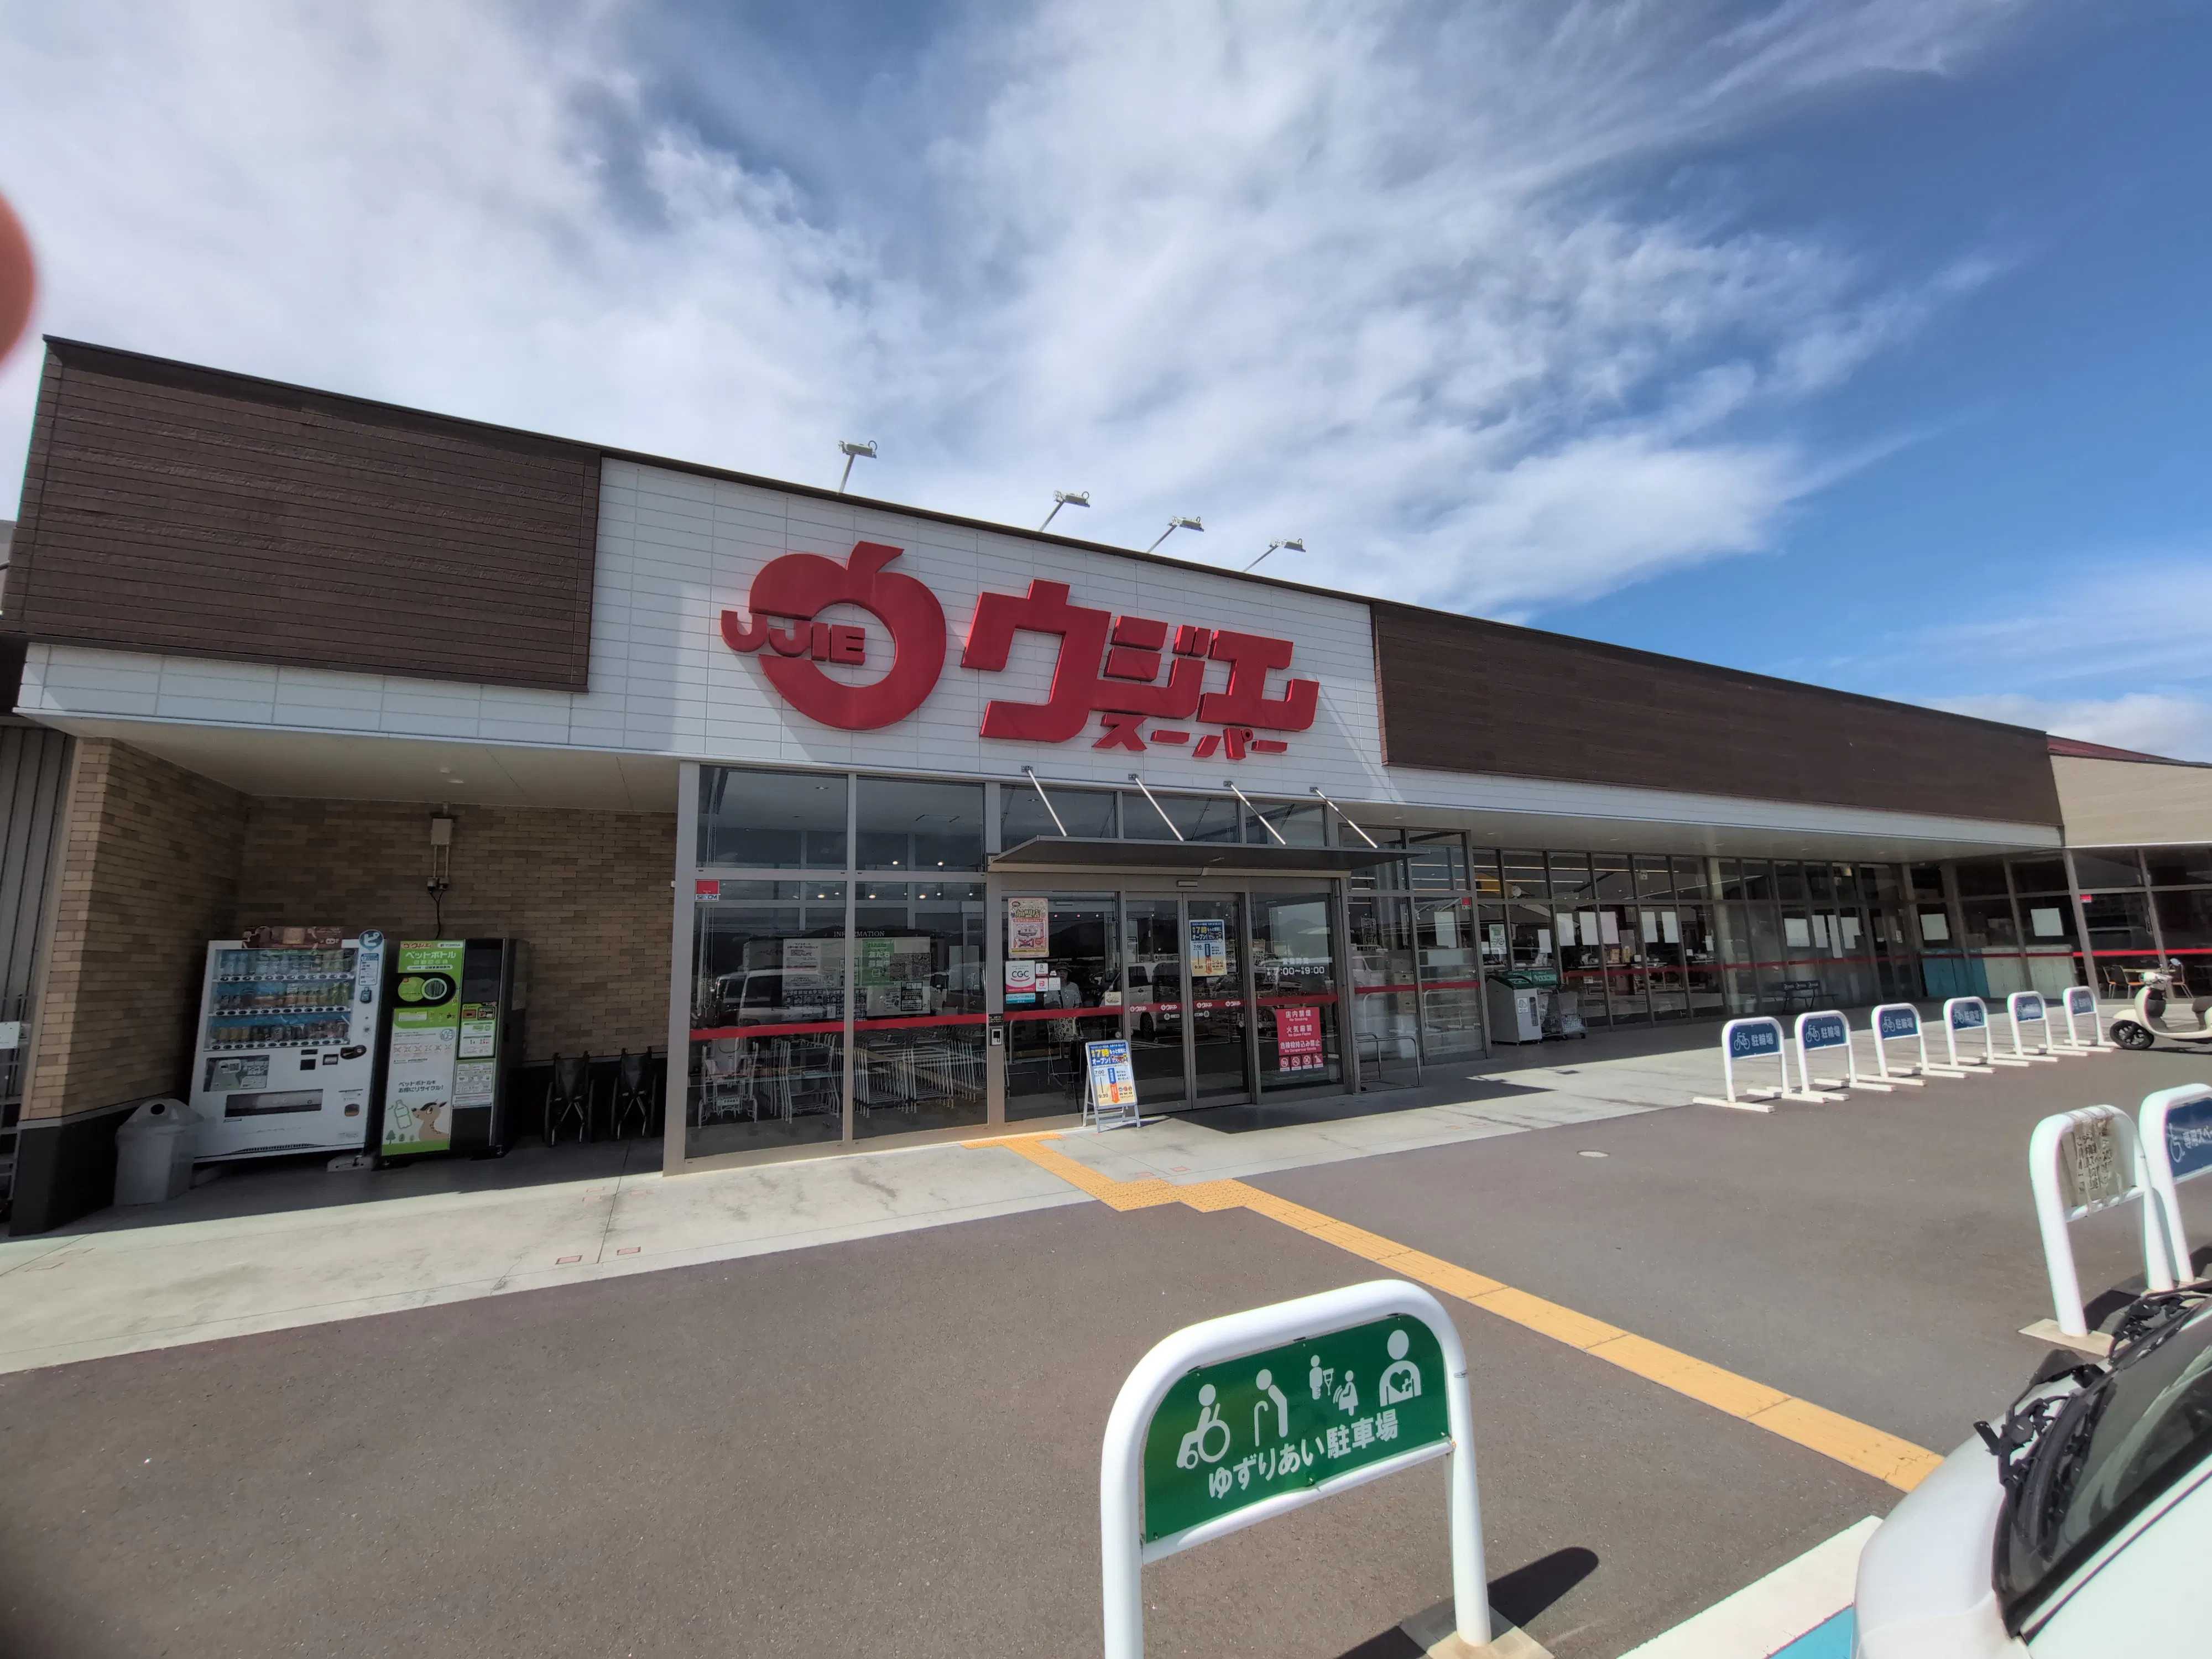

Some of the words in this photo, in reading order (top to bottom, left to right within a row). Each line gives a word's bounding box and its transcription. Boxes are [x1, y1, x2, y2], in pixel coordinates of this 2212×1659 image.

[721, 609, 865, 666] UJIE
[961, 578, 1319, 743] ウジエ
[1092, 713, 1287, 760] スーパー
[1751, 1033, 1773, 1047] 駐輪場
[1820, 1025, 1841, 1039] 駐輪場
[1895, 1016, 1914, 1029] 駐輪場
[1208, 1408, 1399, 1499] ゆずりあい駐車場
